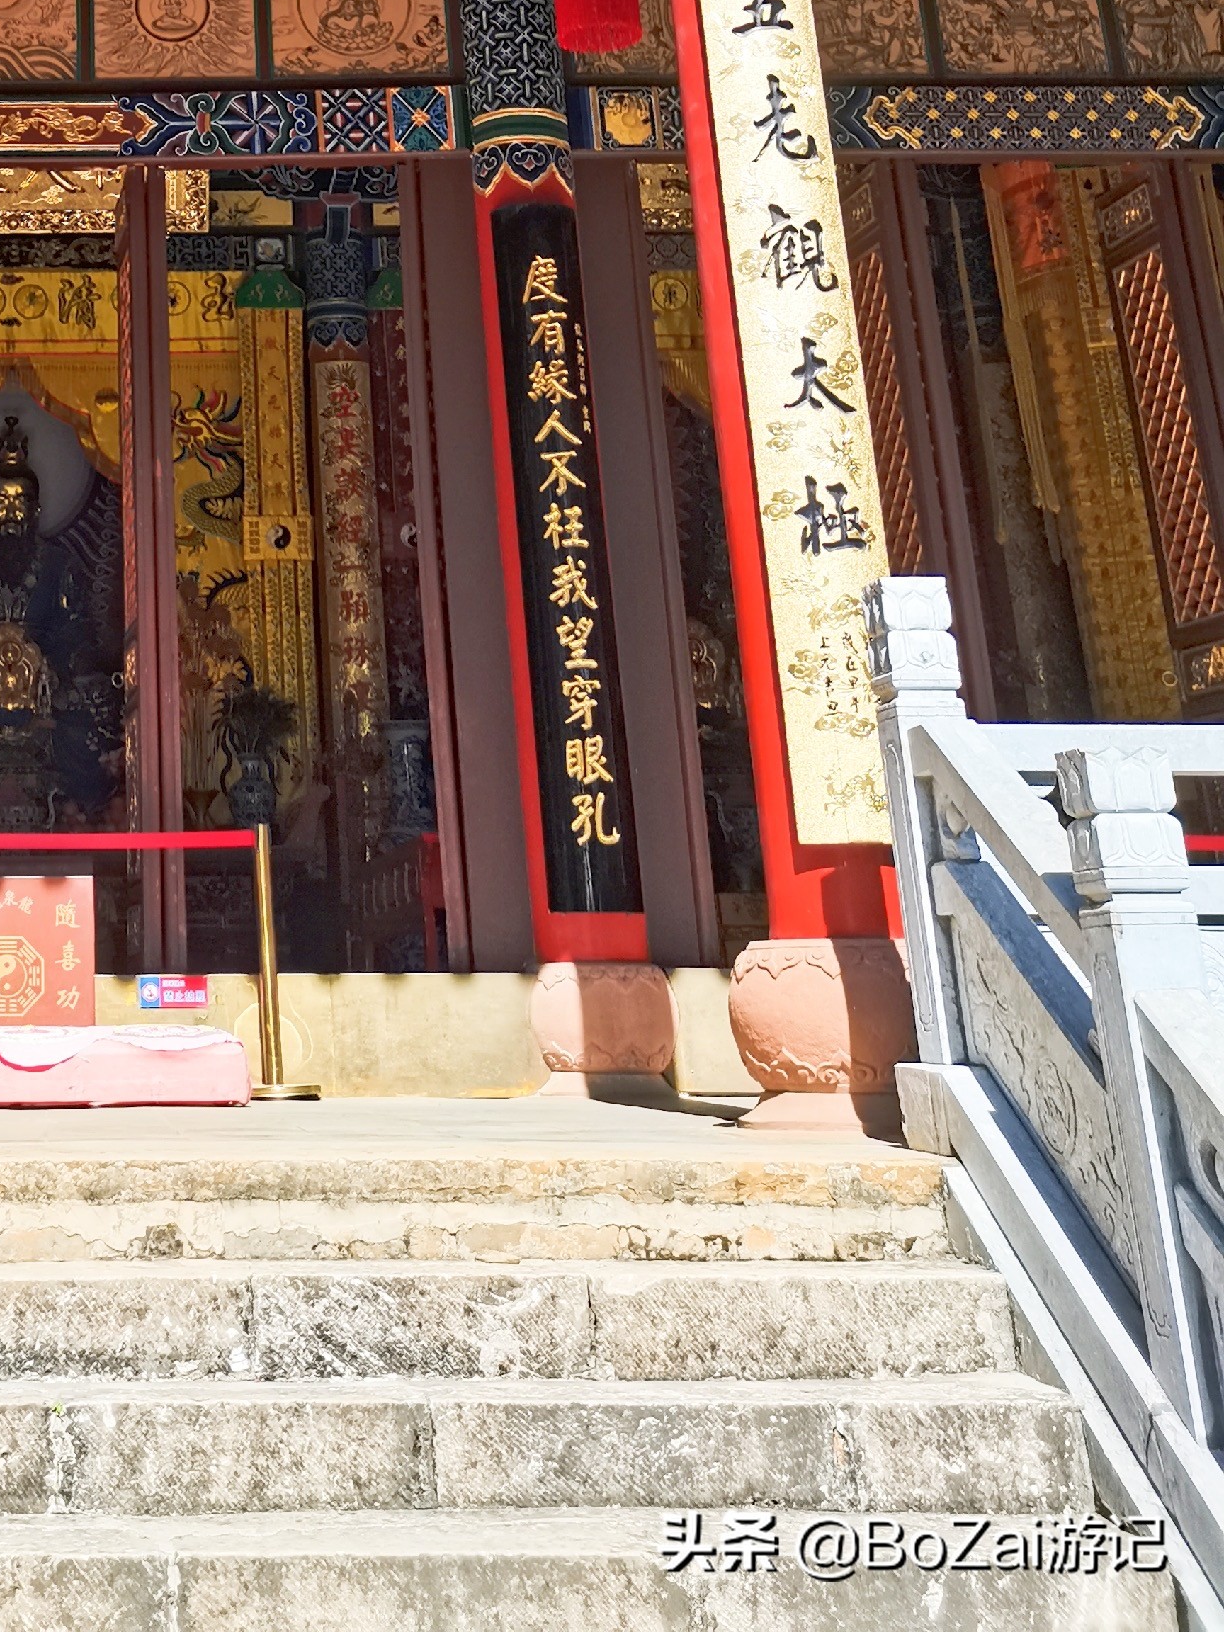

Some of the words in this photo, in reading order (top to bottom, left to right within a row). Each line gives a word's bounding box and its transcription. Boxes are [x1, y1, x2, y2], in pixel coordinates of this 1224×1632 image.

[522, 255, 620, 846] 度有緣人不枉我望穿眼孔
[54, 898, 81, 1010] 隨喜功
